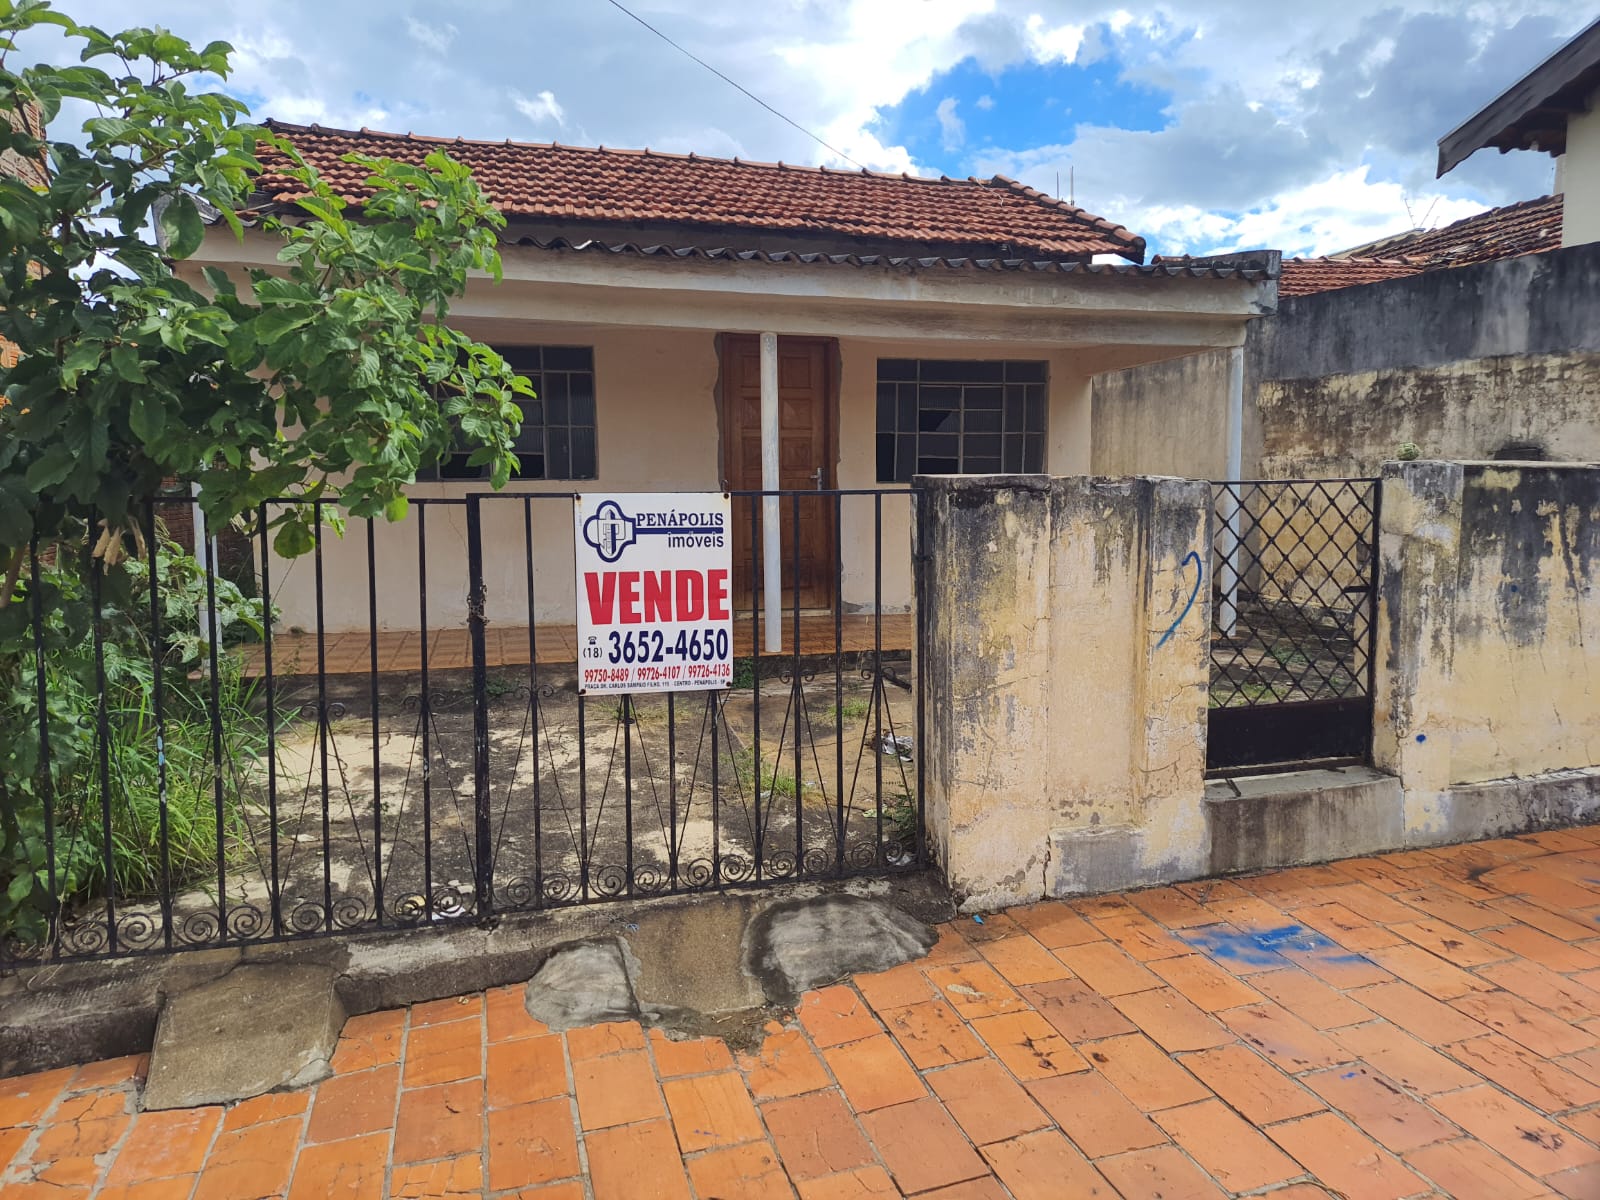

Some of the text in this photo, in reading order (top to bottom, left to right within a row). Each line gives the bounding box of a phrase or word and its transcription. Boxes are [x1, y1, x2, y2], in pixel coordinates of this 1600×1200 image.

[636, 509, 724, 526] PENÁPOLIS
[668, 531, 724, 548] imóveis
[584, 569, 730, 626] VENDE
[583, 628, 729, 664] (18) 3652-4650
[584, 668, 629, 682] 99750-8489
[637, 666, 681, 681] 99726-4107
[688, 664, 730, 678] 99726-4136
